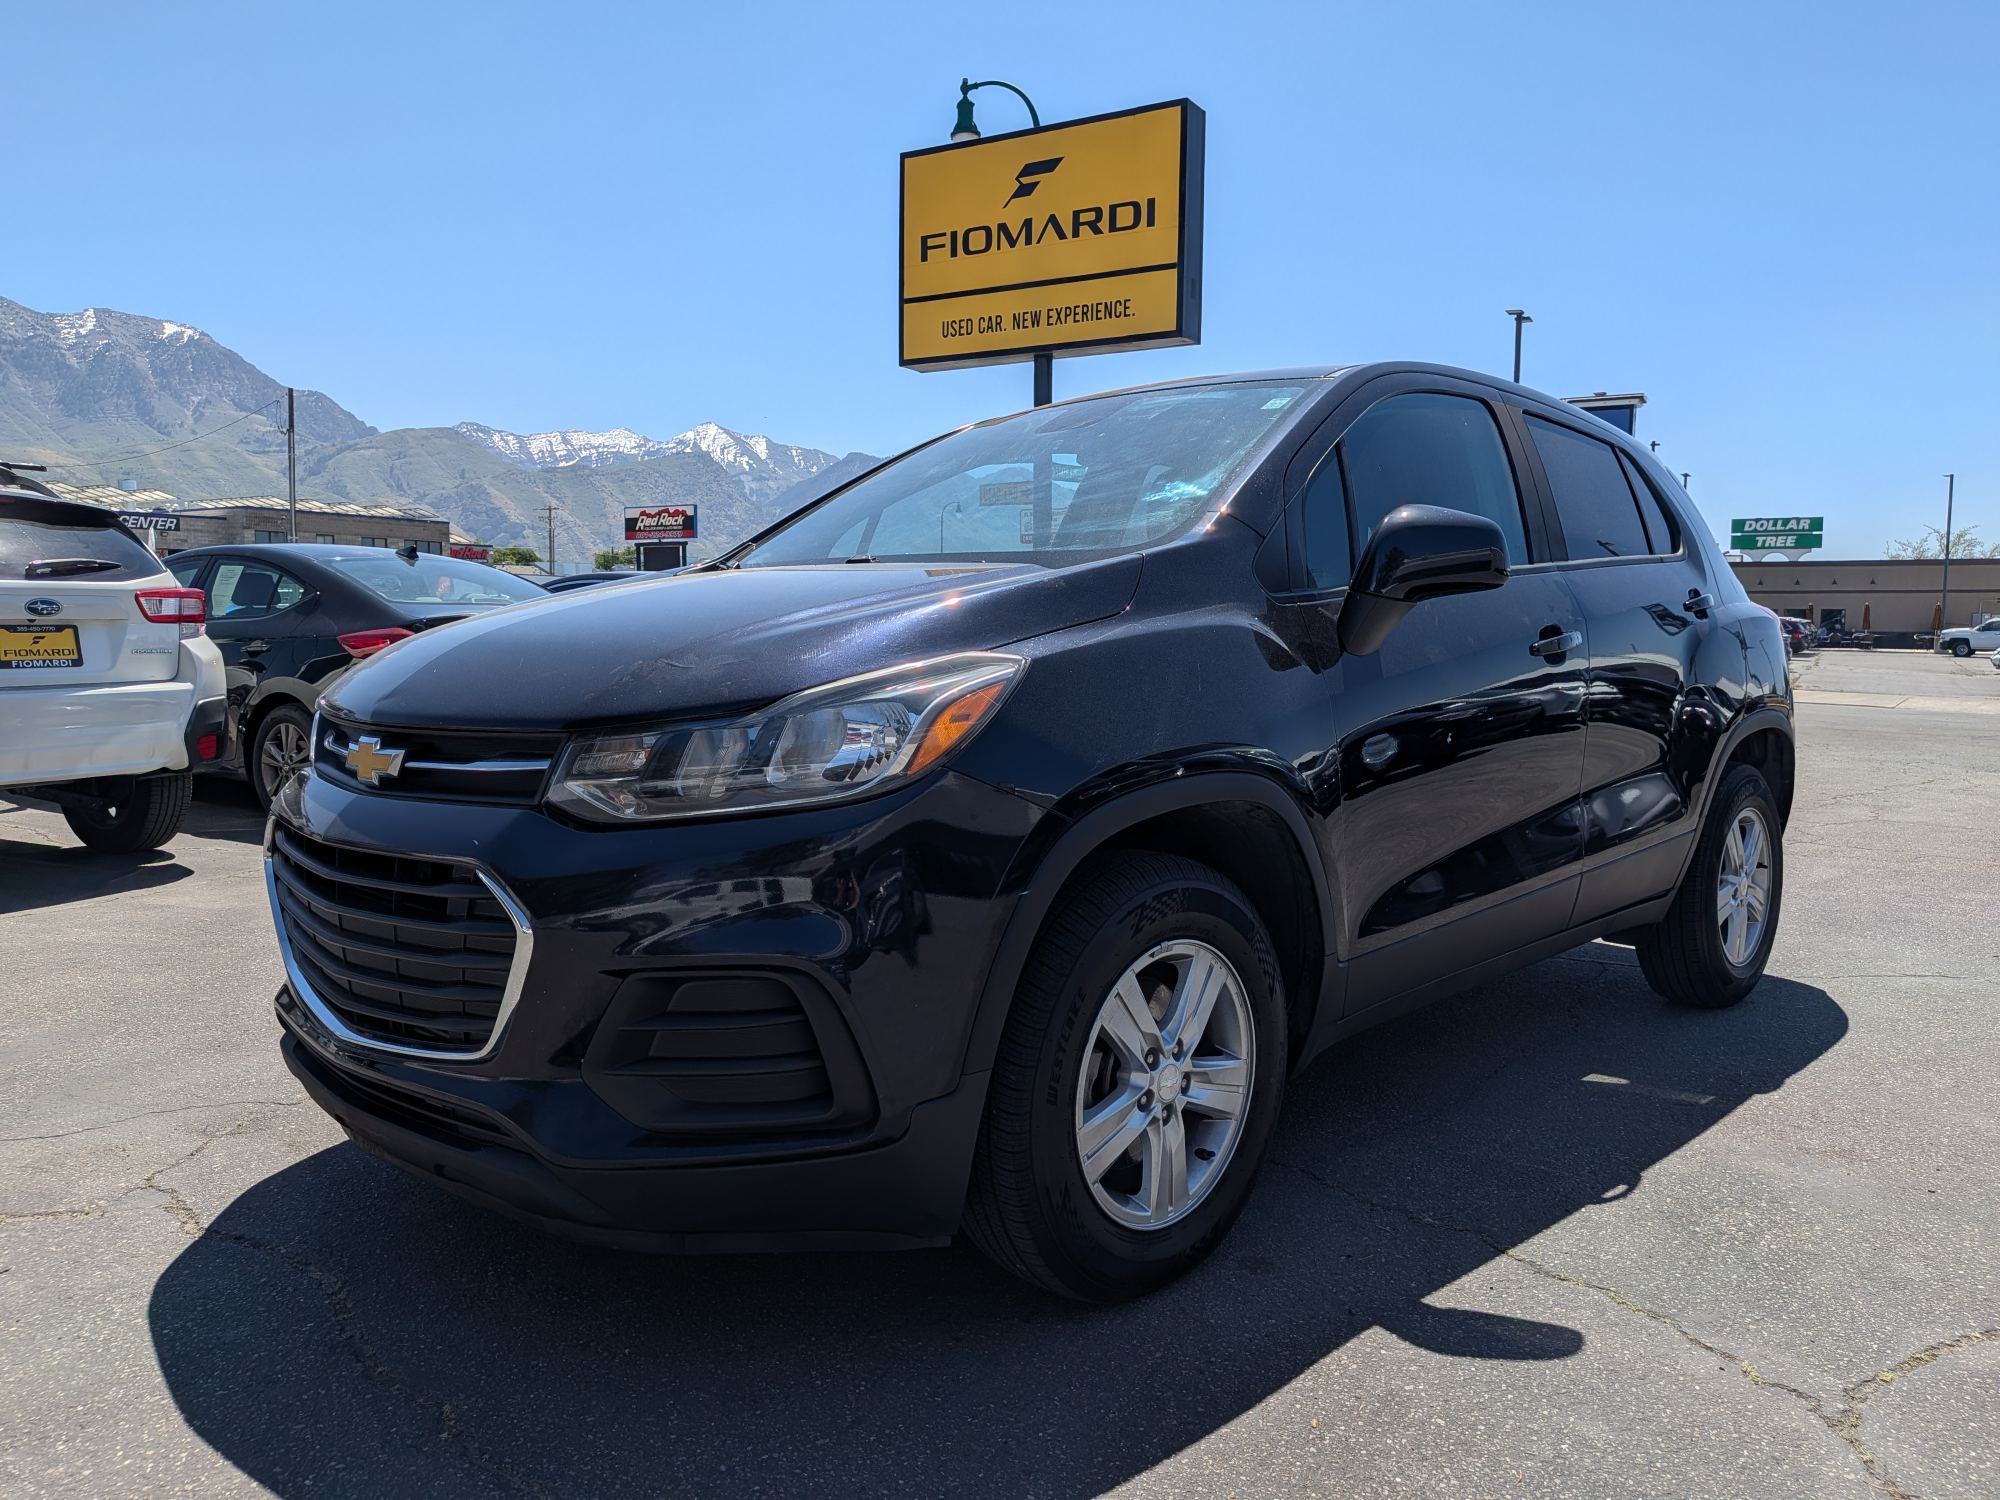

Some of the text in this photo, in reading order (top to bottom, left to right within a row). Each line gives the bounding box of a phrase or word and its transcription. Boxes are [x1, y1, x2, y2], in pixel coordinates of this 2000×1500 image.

[920, 197, 1156, 263] FIOMARDI
[942, 299, 1136, 338] USED CAR. NEW EXPERIENCE.
[119, 515, 177, 530] CENTER
[635, 512, 686, 531] Red Rock
[1743, 518, 1811, 532] DOLLAR
[1755, 535, 1797, 548] TREE
[3, 648, 75, 657] FIOMARDI
[12, 660, 72, 668] FIOMARDI
